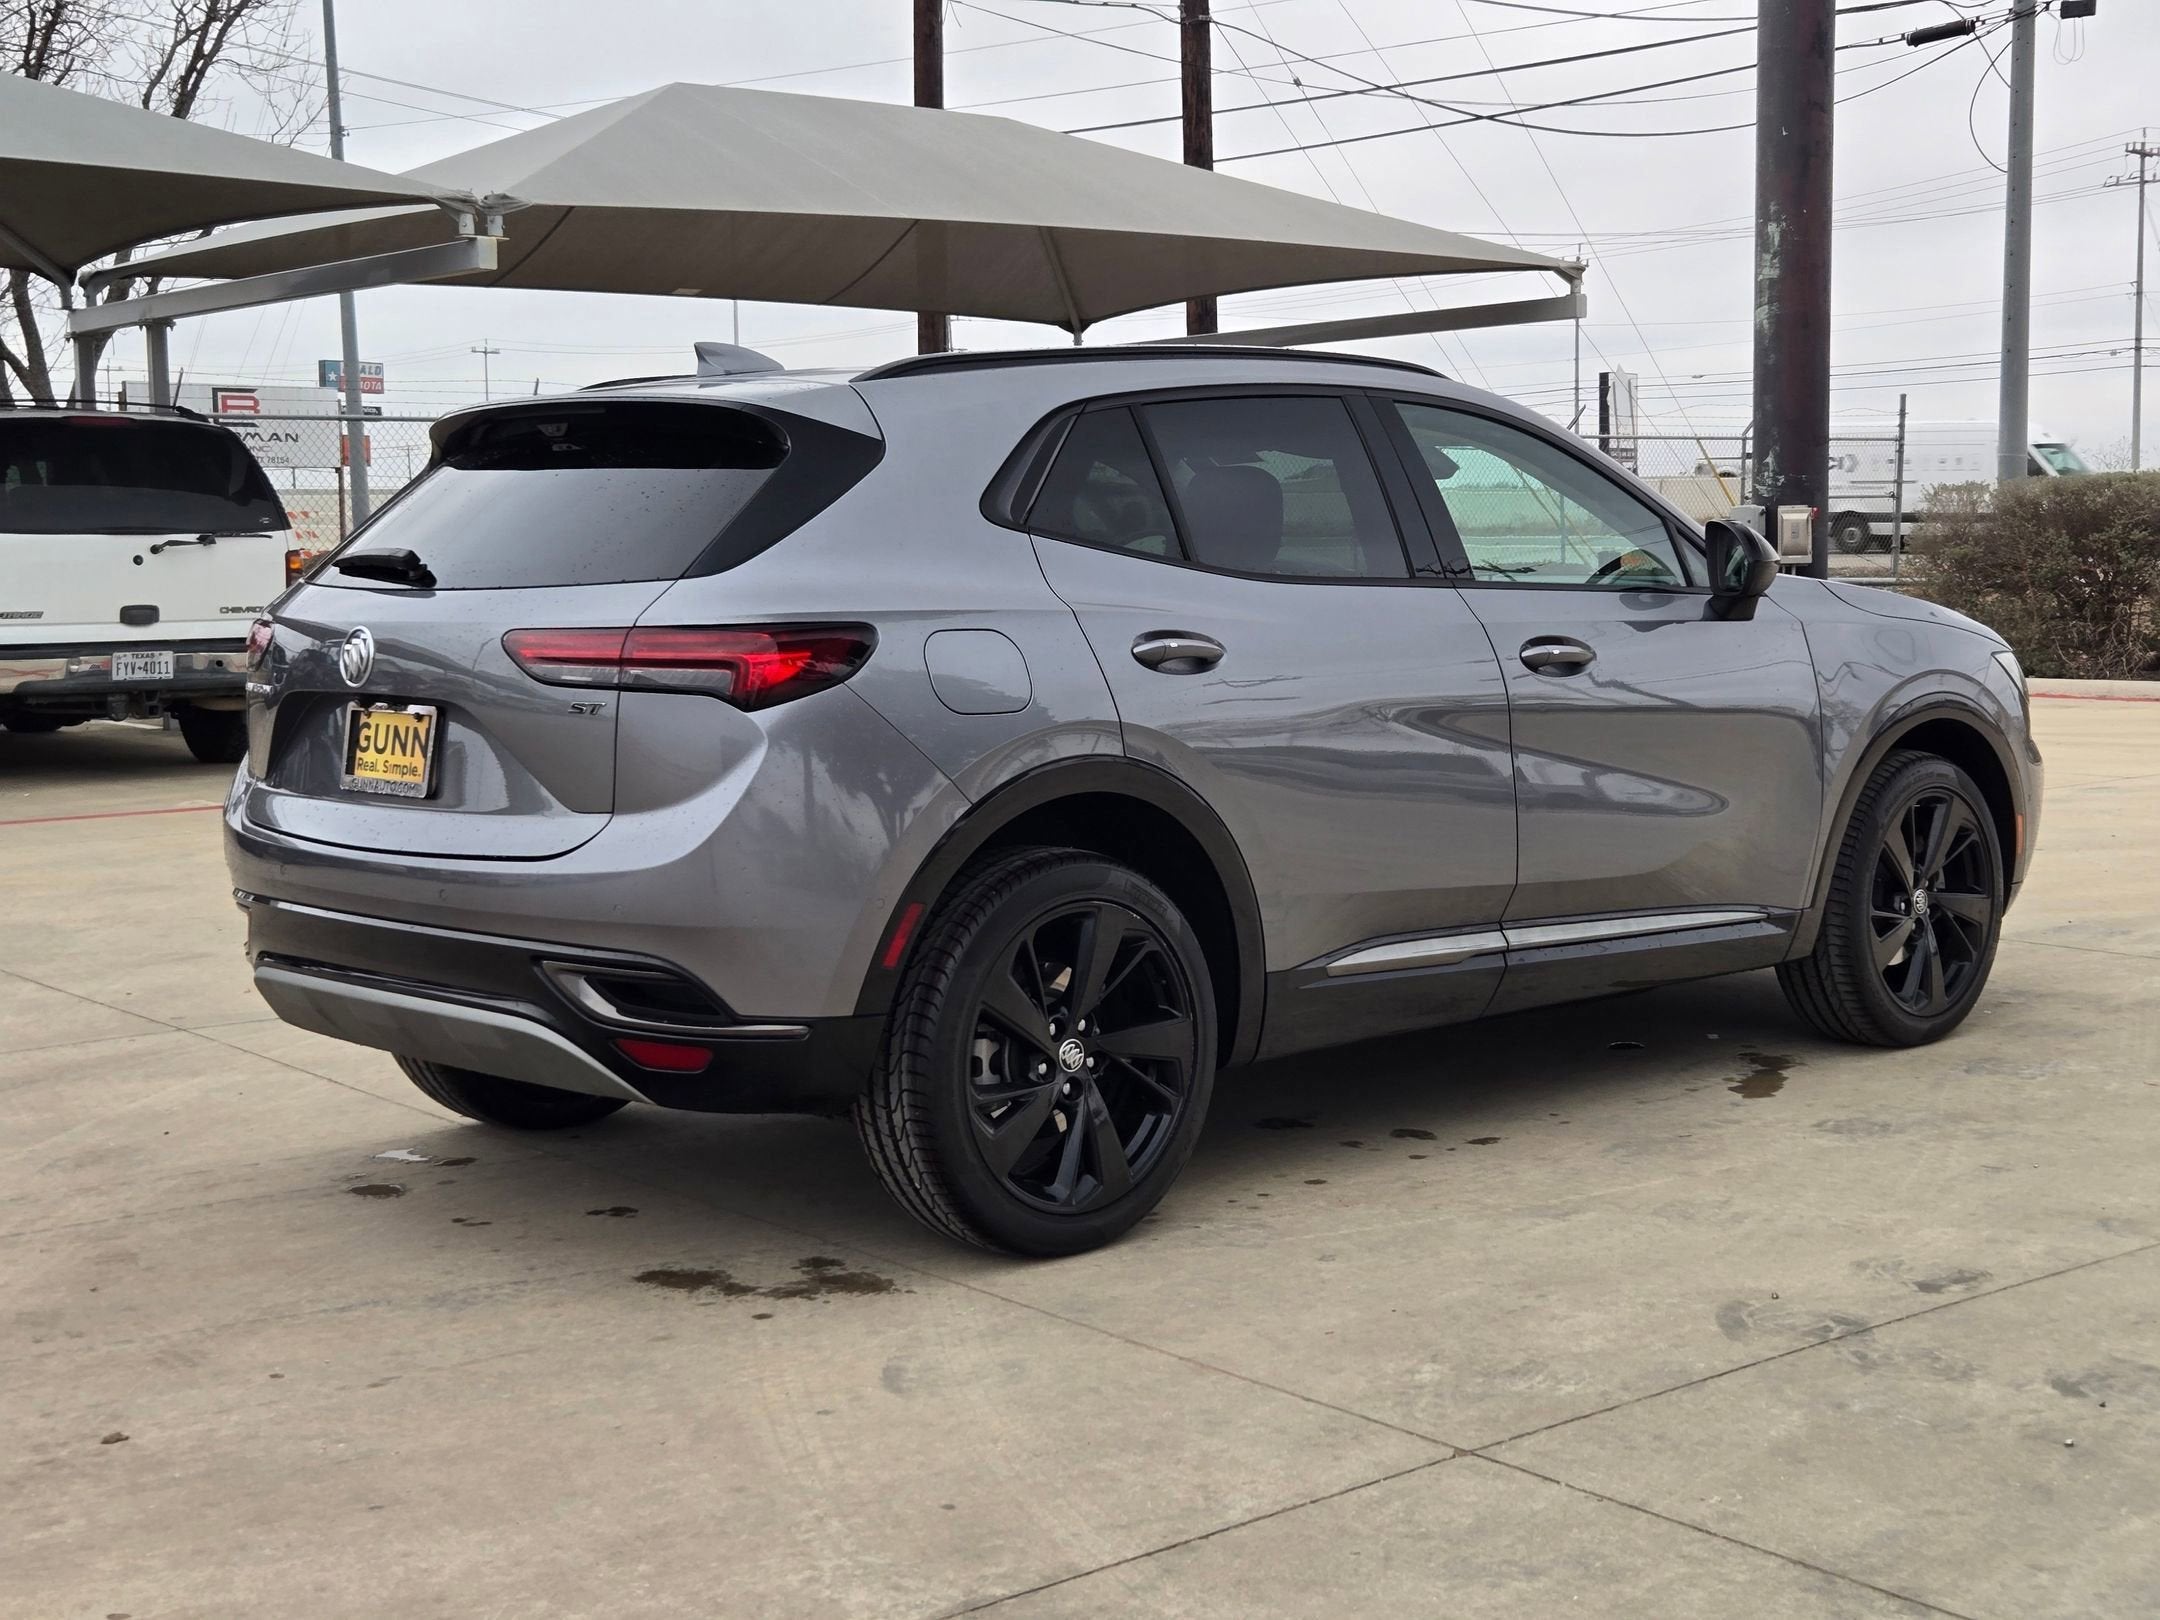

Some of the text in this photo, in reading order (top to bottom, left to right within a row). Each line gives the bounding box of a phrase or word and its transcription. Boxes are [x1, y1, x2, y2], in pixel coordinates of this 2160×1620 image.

[236, 431, 299, 442] MAN
[131, 652, 156, 660] TEXAS
[568, 701, 607, 715] ST
[358, 721, 430, 759] GUNN
[356, 757, 422, 778] Real. Simple.
